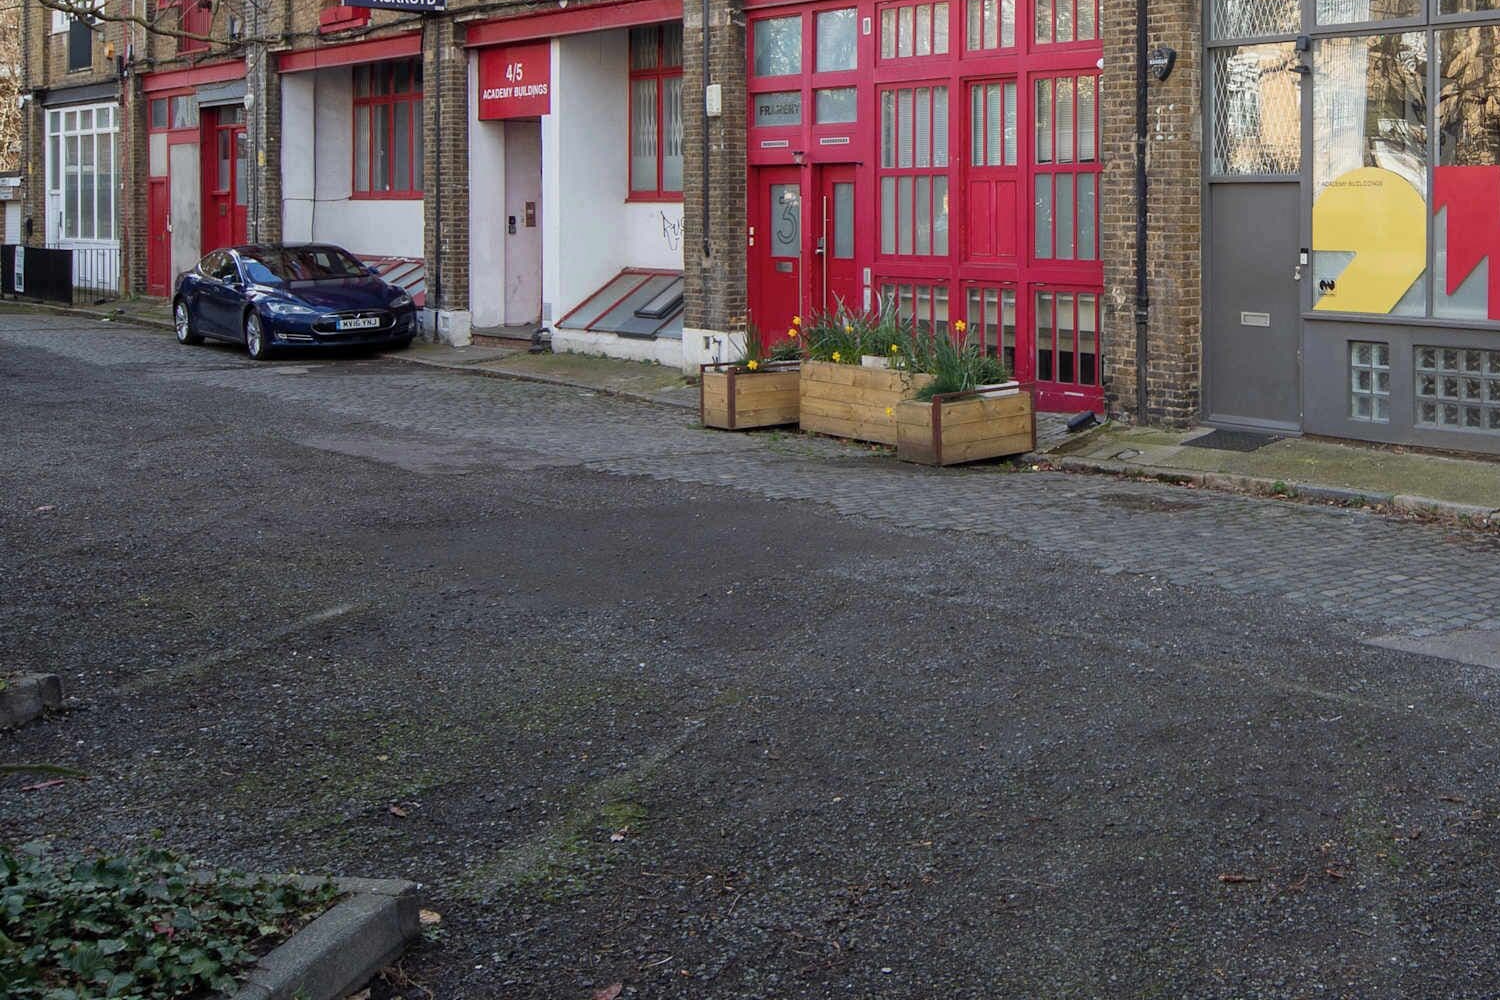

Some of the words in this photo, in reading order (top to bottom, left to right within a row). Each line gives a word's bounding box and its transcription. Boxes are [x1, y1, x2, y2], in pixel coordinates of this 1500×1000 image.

[506, 62, 522, 83] 4/5
[482, 86, 512, 100] ACADEMY
[513, 83, 548, 97] BUILDINGS
